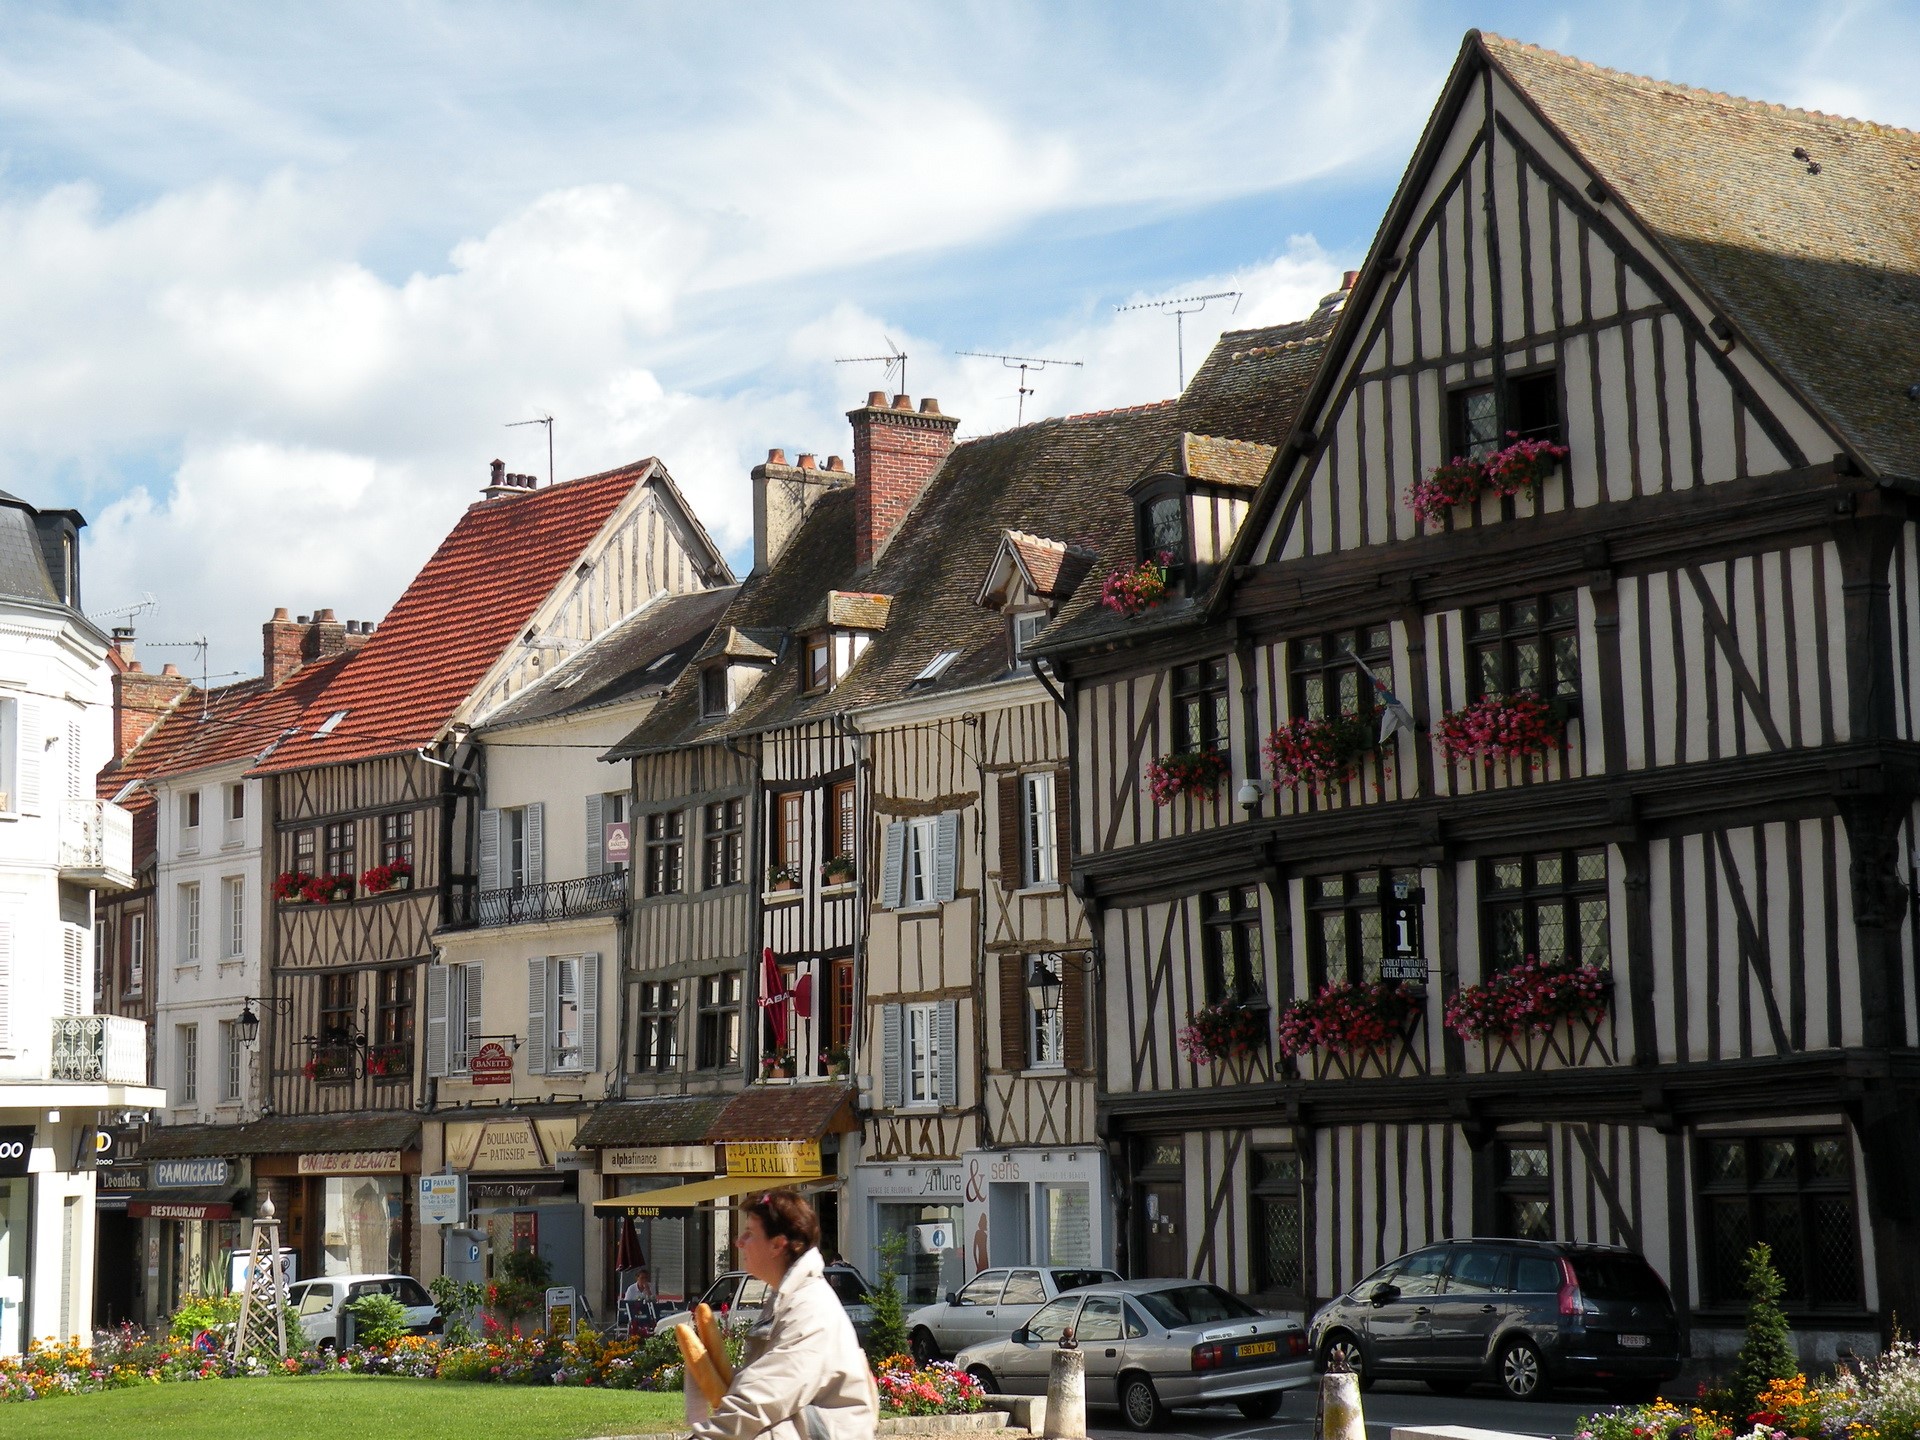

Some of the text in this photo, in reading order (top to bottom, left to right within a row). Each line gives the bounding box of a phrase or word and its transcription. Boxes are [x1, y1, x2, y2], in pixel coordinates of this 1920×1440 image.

[1383, 967, 1399, 978] OFFICE
[476, 1060, 509, 1068] BANETTE
[487, 1132, 529, 1146] BOULANGER
[490, 1147, 526, 1161] PATISSIER
[611, 1151, 658, 1168] alphafinance
[96, 1158, 114, 1166] 2000
[746, 1158, 799, 1173] LE RALLYE
[159, 1162, 226, 1183] PAMUKKALE
[104, 1172, 141, 1188] Leonidas
[433, 1179, 456, 1187] PAYANT
[920, 1158, 1021, 1203] Allure & sens
[151, 1205, 207, 1219] RESTAURANT
[628, 1207, 660, 1216] LE RALLYE
[1240, 1345, 1256, 1356] 1981
[1267, 1342, 1275, 1352] 27
